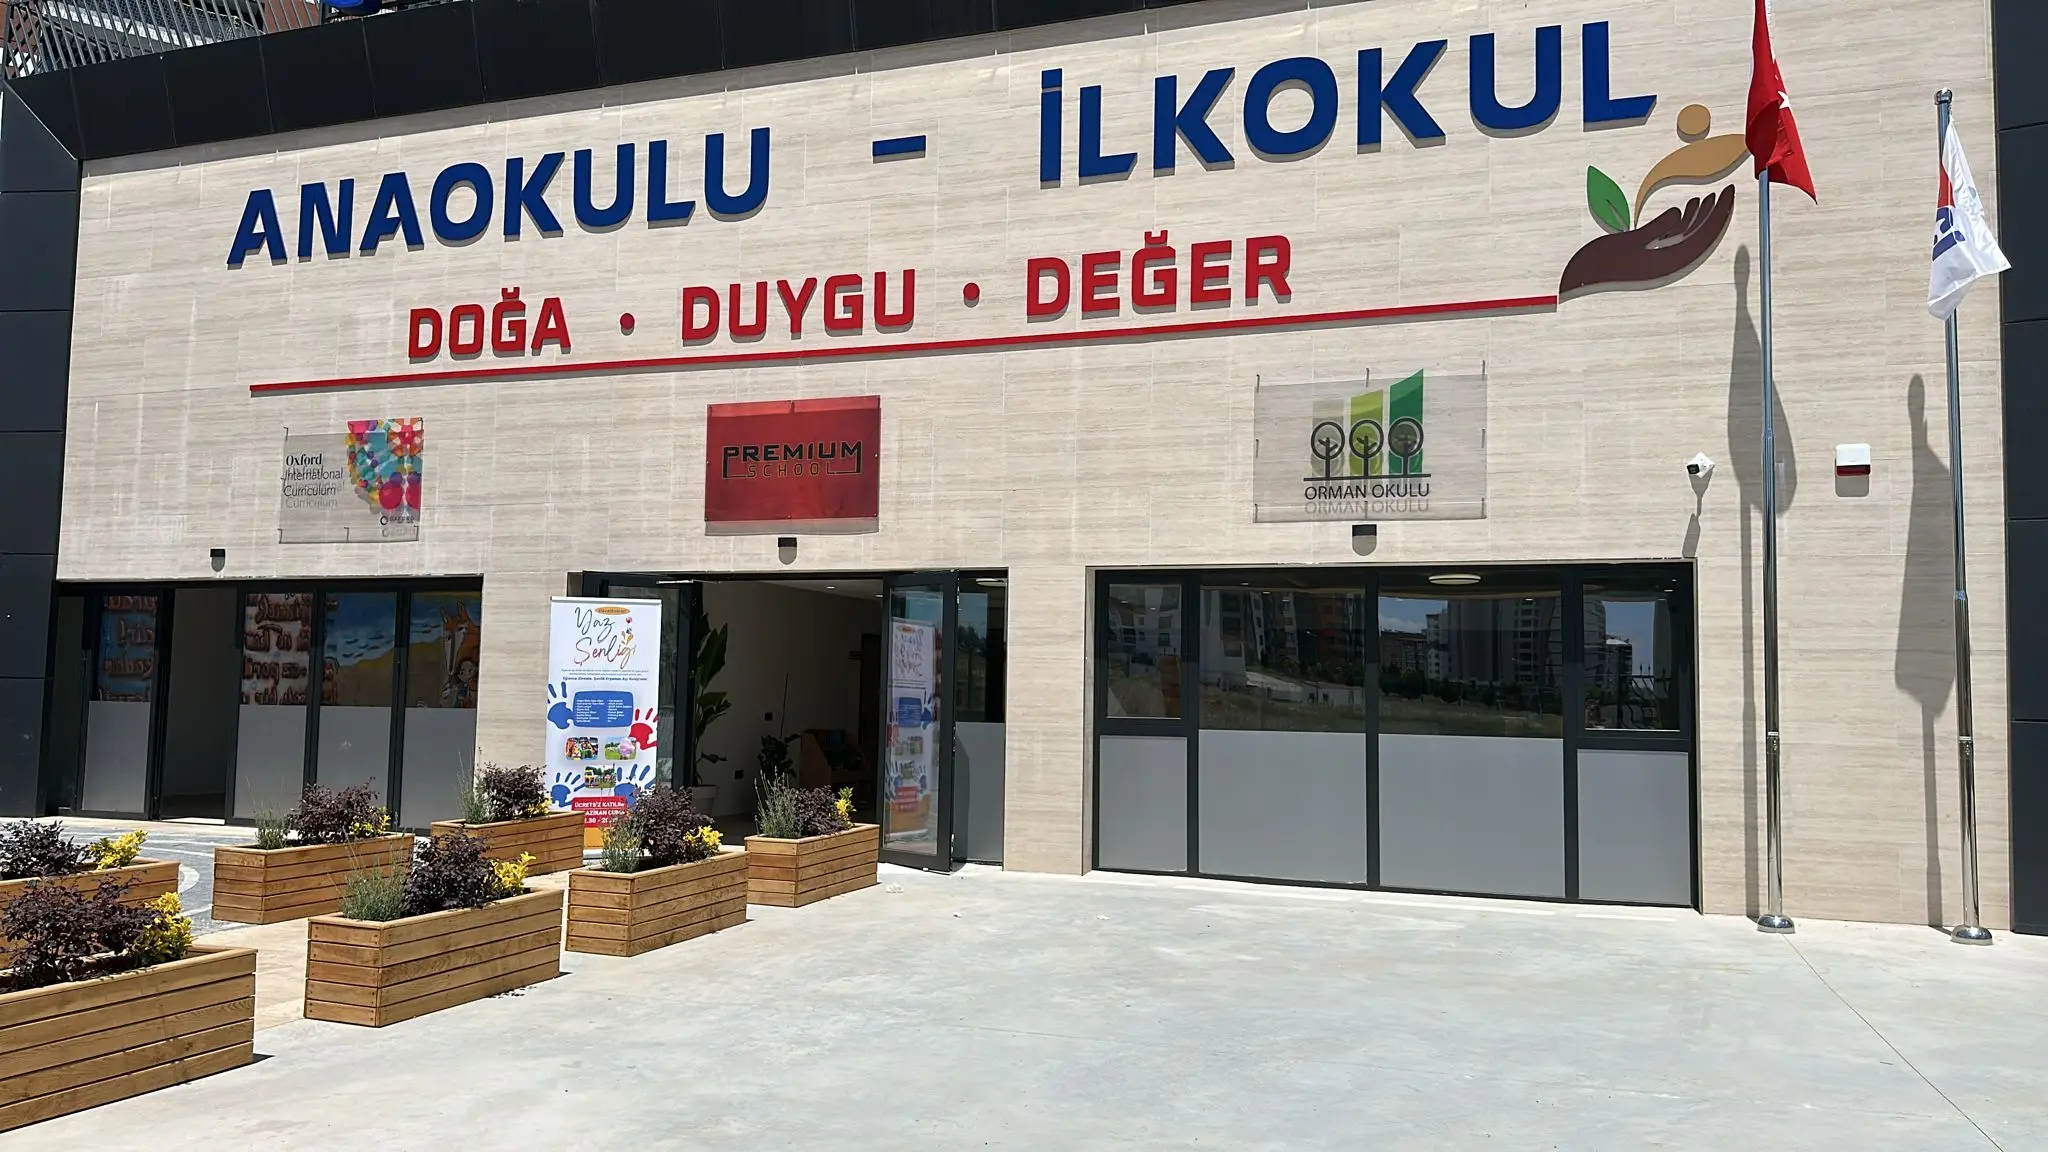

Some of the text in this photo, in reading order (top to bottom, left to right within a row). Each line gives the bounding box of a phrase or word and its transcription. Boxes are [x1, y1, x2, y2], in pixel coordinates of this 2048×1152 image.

[228, 128, 770, 265] ANAOKULU
[1040, 22, 1656, 183] İLKOKUL
[408, 230, 1292, 358] DOĞA DUYGU DEĞER
[285, 453, 322, 467] Oxford
[722, 440, 862, 471] PREMIUM
[748, 461, 837, 478] SCHOOL
[284, 484, 337, 498] Curriculum
[1304, 482, 1430, 501] ORMAN OKULU
[574, 606, 616, 644] Yaz
